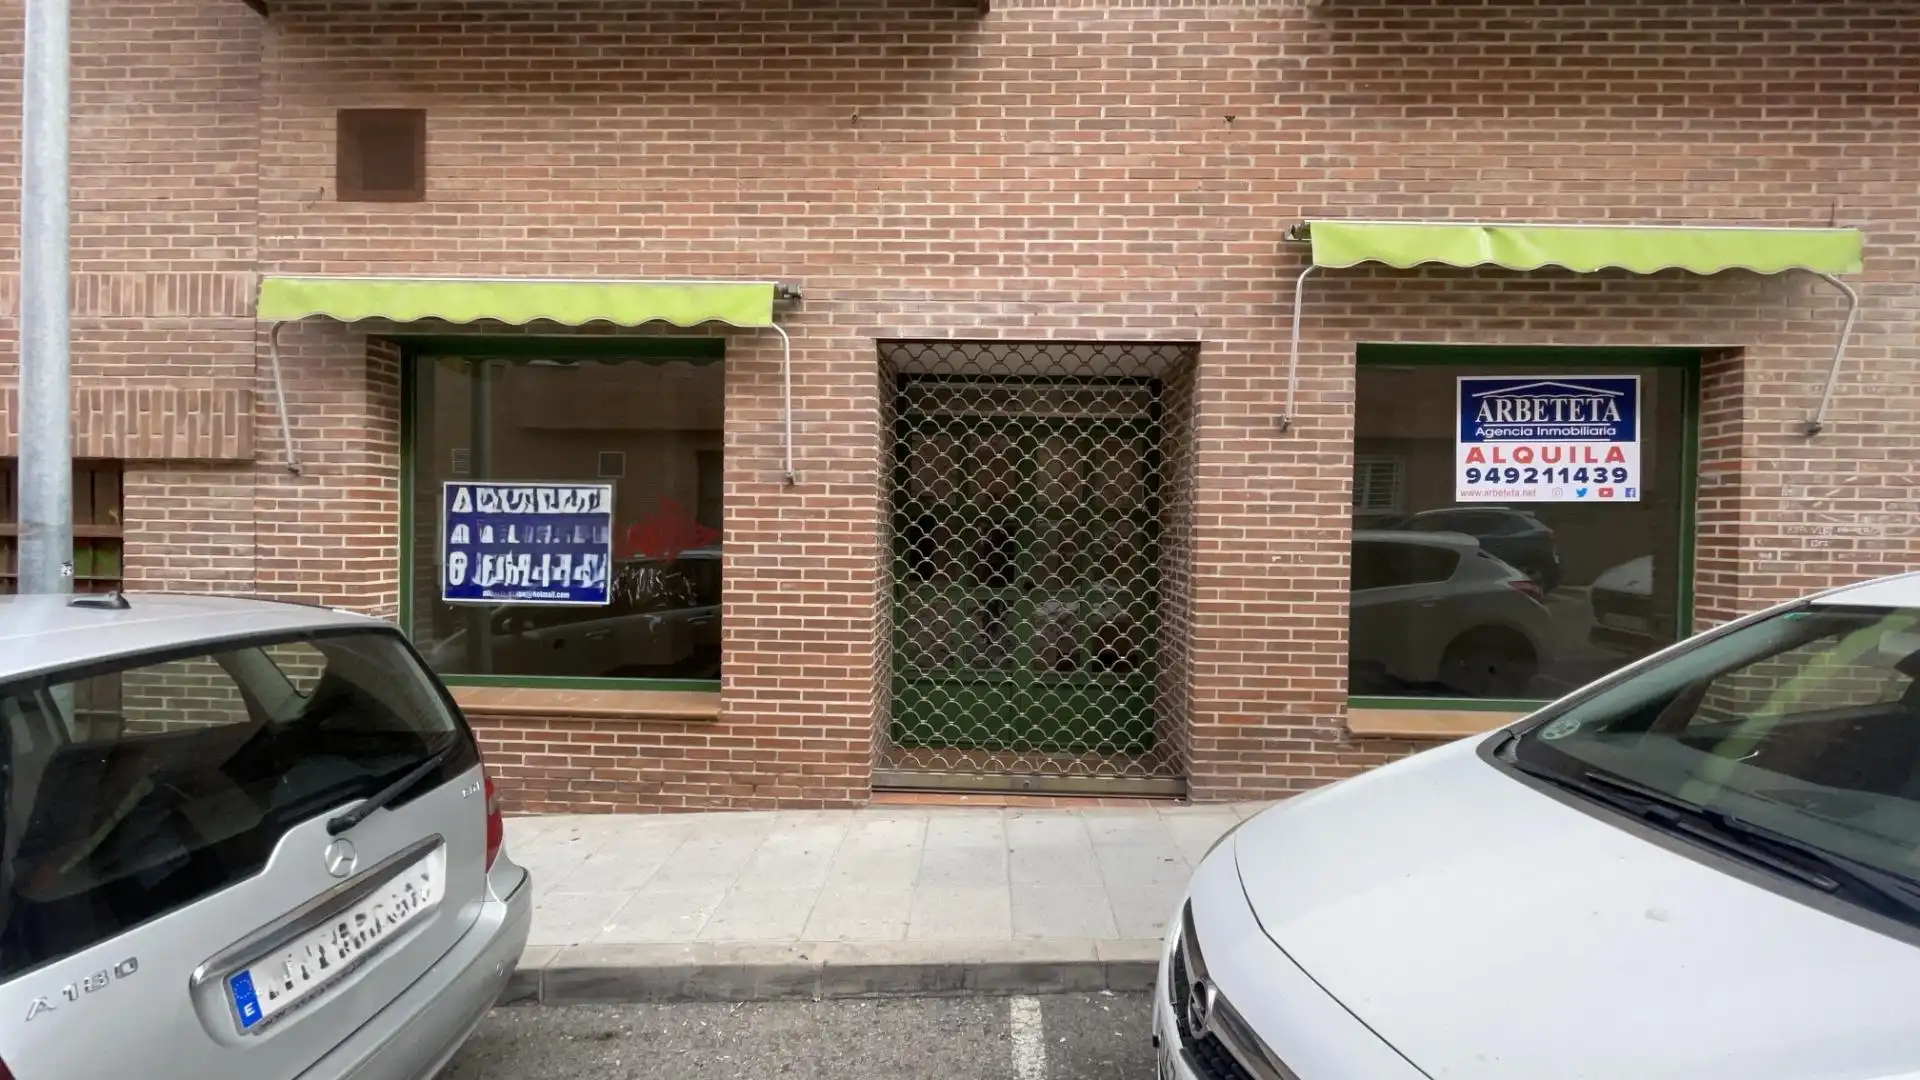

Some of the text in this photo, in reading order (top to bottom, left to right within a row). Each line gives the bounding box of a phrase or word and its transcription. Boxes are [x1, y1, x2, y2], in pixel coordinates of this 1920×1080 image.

[1475, 398, 1622, 422] ARBETETA
[1475, 426, 1617, 438] Agencia Inmobiliaria
[1465, 446, 1626, 464] ALQUILA
[1465, 467, 1628, 484] 949211439
[1460, 488, 1536, 498] www.arbeteta.net
[23, 996, 57, 1022] A
[244, 1002, 256, 1017] E
